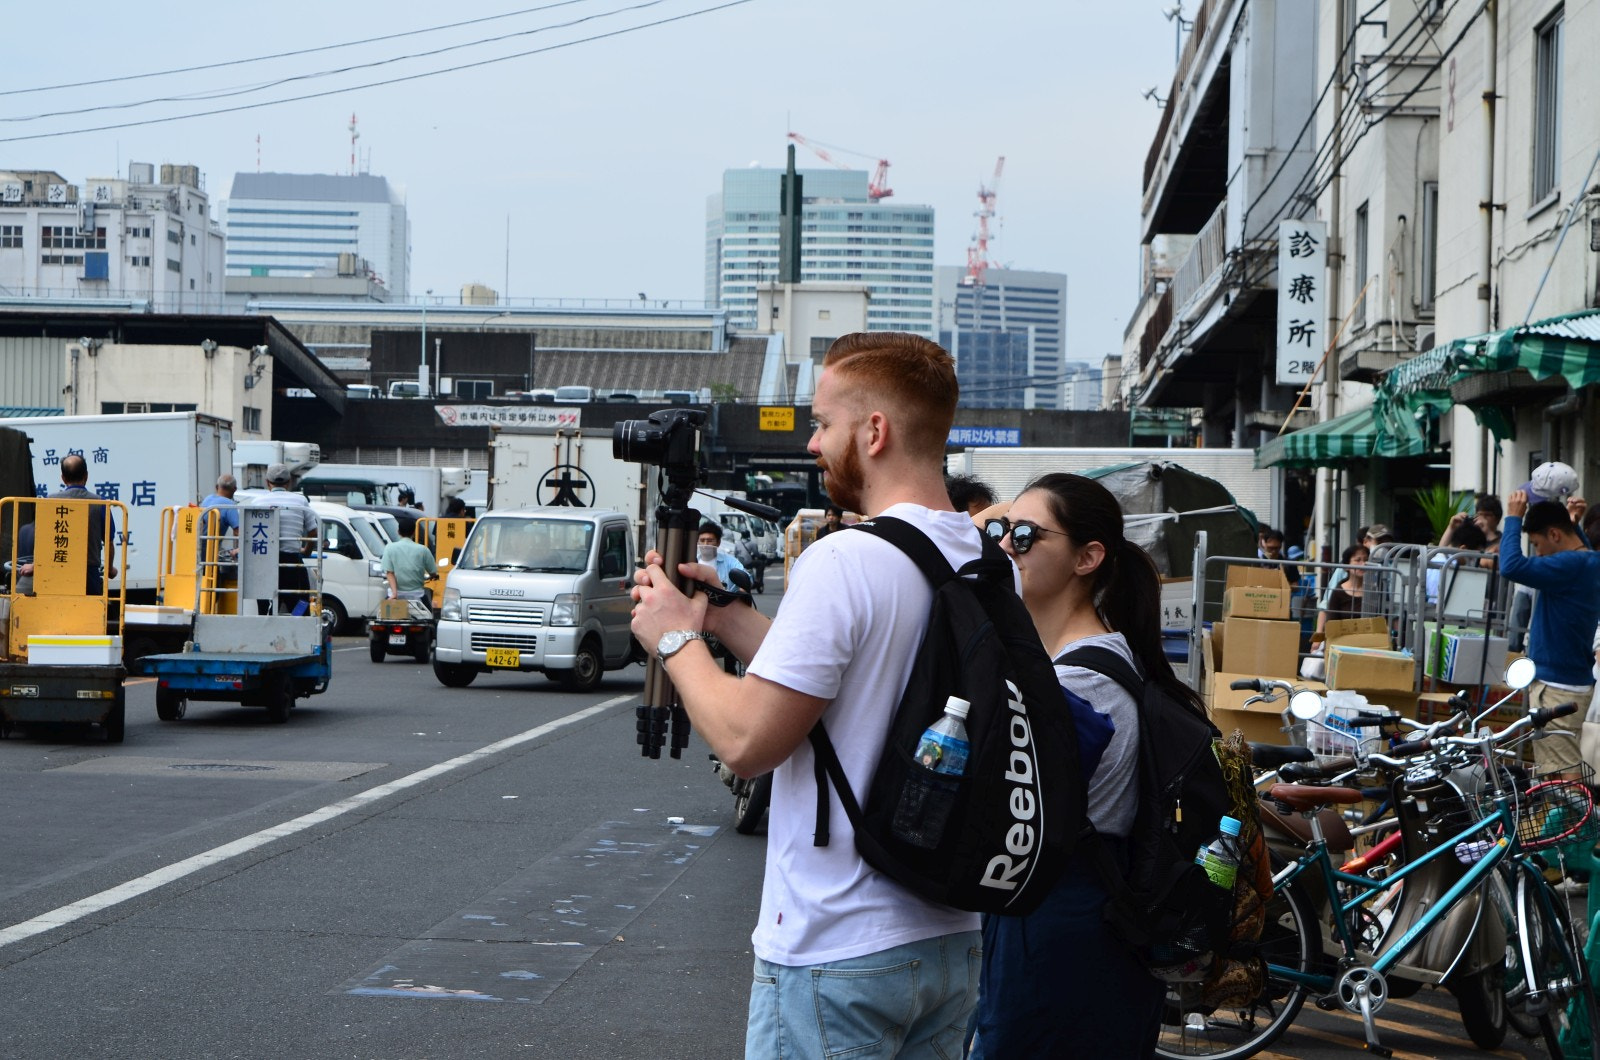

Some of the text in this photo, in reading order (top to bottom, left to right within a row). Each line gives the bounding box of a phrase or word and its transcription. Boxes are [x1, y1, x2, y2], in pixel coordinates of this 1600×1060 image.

[1287, 230, 1319, 348] 診療所
[53, 505, 69, 563] 中松物産
[252, 522, 268, 555] 大祐
[490, 589, 524, 597] SUZUKI
[979, 679, 1036, 890] Reebok
